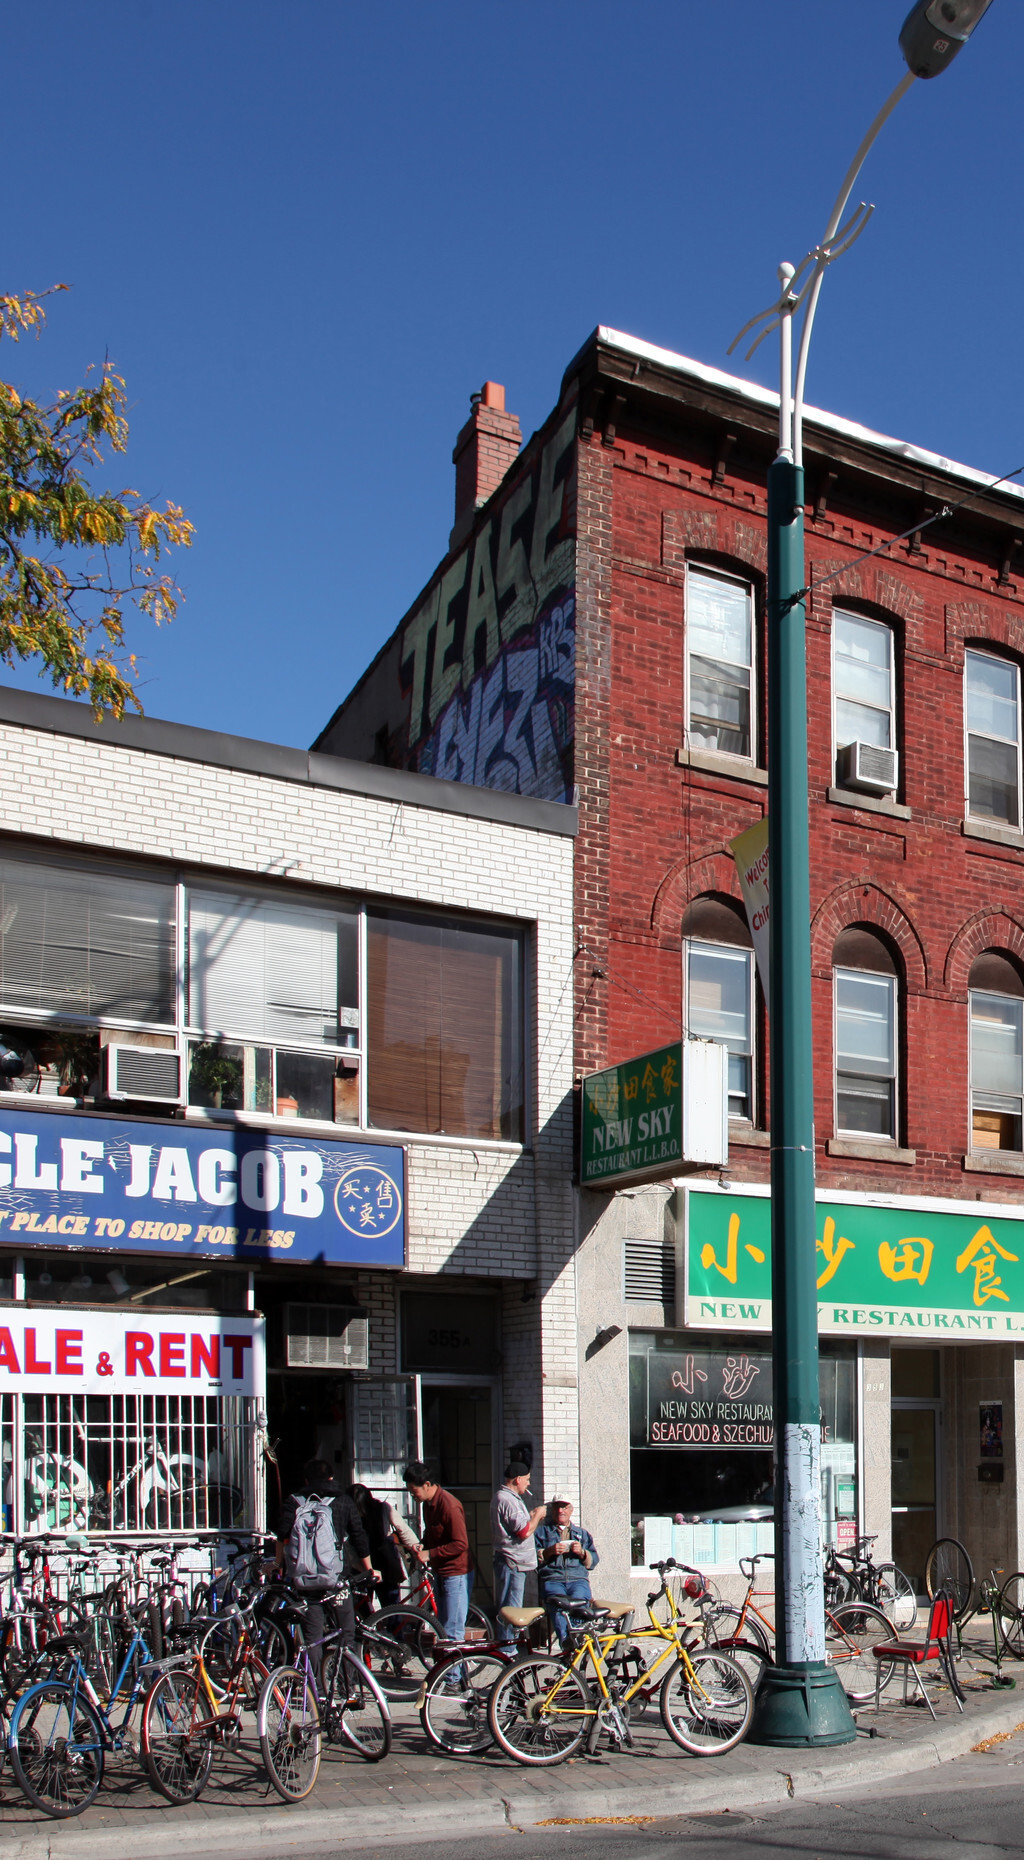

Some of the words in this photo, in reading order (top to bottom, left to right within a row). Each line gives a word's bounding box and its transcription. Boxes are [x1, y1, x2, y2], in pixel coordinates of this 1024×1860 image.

[592, 1117, 633, 1155] NEW
[637, 1104, 676, 1142] SKY
[586, 1148, 643, 1177] RESTAURANT
[643, 1138, 681, 1162] L.L.B.O.
[125, 1144, 324, 1218] JACOB
[9, 1212, 91, 1235] PLACE
[94, 1218, 126, 1238] TO
[128, 1221, 192, 1242] SHOP
[194, 1225, 239, 1245] FOR
[243, 1228, 296, 1249] LESS
[700, 1303, 762, 1319] NEW
[833, 1308, 998, 1330] RESTAURANT
[427, 1328, 461, 1349] 355
[96, 1351, 114, 1377] &
[125, 1331, 253, 1379] RENT
[660, 1401, 688, 1419] NEW
[690, 1401, 714, 1419] SKY
[717, 1403, 774, 1421] RESTAURA
[651, 1422, 710, 1442] SEAFOOD
[711, 1424, 721, 1444] &
[839, 1527, 856, 1537] OPEN
